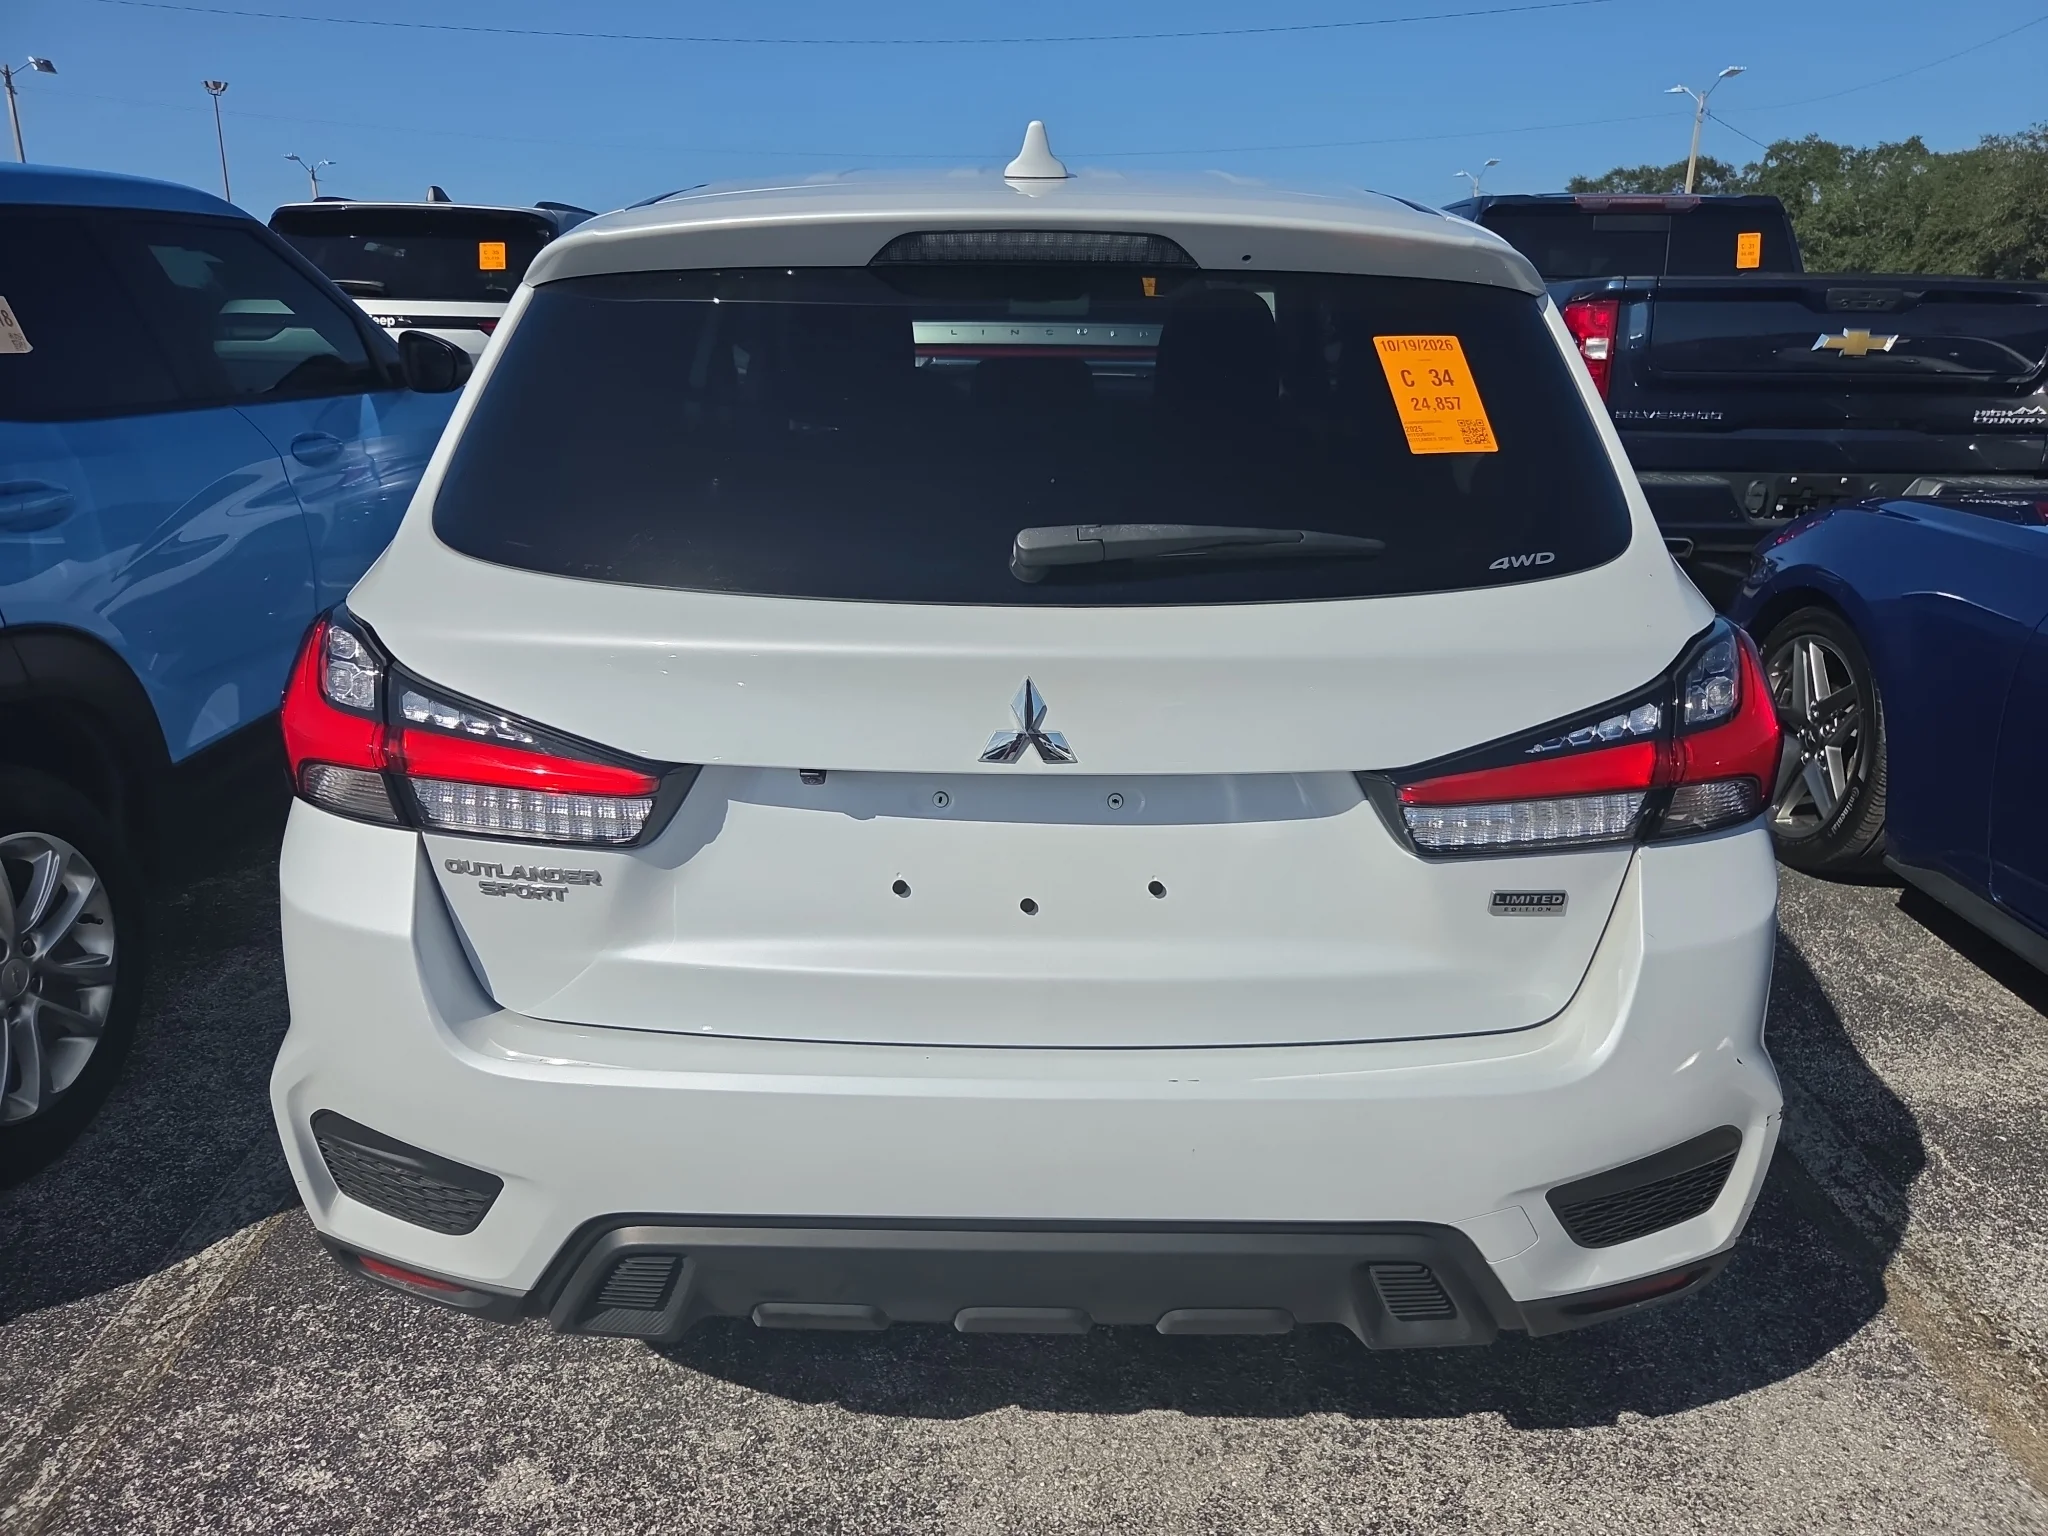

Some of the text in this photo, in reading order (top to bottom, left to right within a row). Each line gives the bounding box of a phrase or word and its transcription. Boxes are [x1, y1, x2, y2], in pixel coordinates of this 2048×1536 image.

[369, 315, 396, 328] eep
[1380, 339, 1454, 352] 10/19/2026
[1400, 368, 1454, 388] C 34
[1410, 396, 1462, 413] 24,857
[1972, 416, 2046, 424] COUNTRY
[1488, 552, 1555, 570] 4WD
[444, 858, 602, 886] OUTLANDER
[478, 880, 569, 902] SPORT
[1495, 894, 1563, 904] LIMITED
